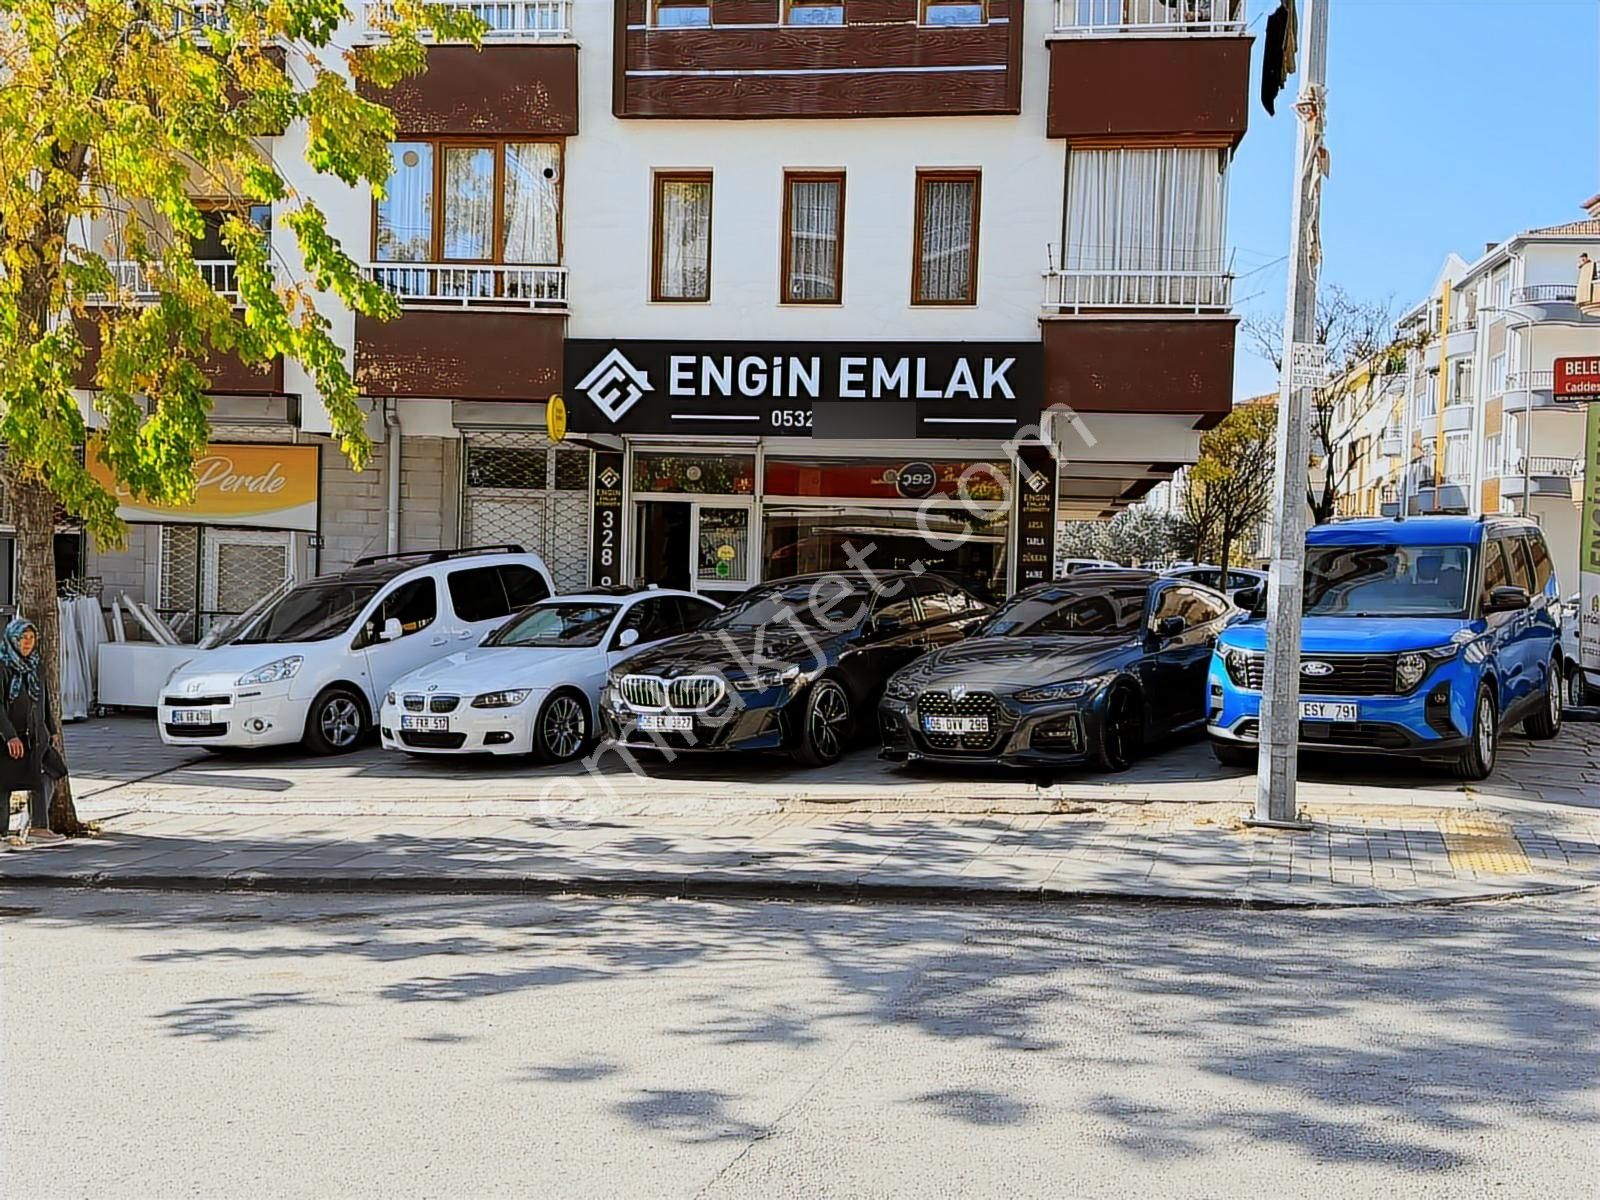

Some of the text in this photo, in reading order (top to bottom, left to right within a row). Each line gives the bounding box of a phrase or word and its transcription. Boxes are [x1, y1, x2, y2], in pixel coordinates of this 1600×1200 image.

[1566, 360, 1600, 375] BELE
[839, 356, 1016, 399] EMLAK
[771, 410, 813, 427] 0532
[196, 456, 287, 494] Perde
[1304, 703, 1356, 718] ESY 791
[968, 719, 988, 731] 296
